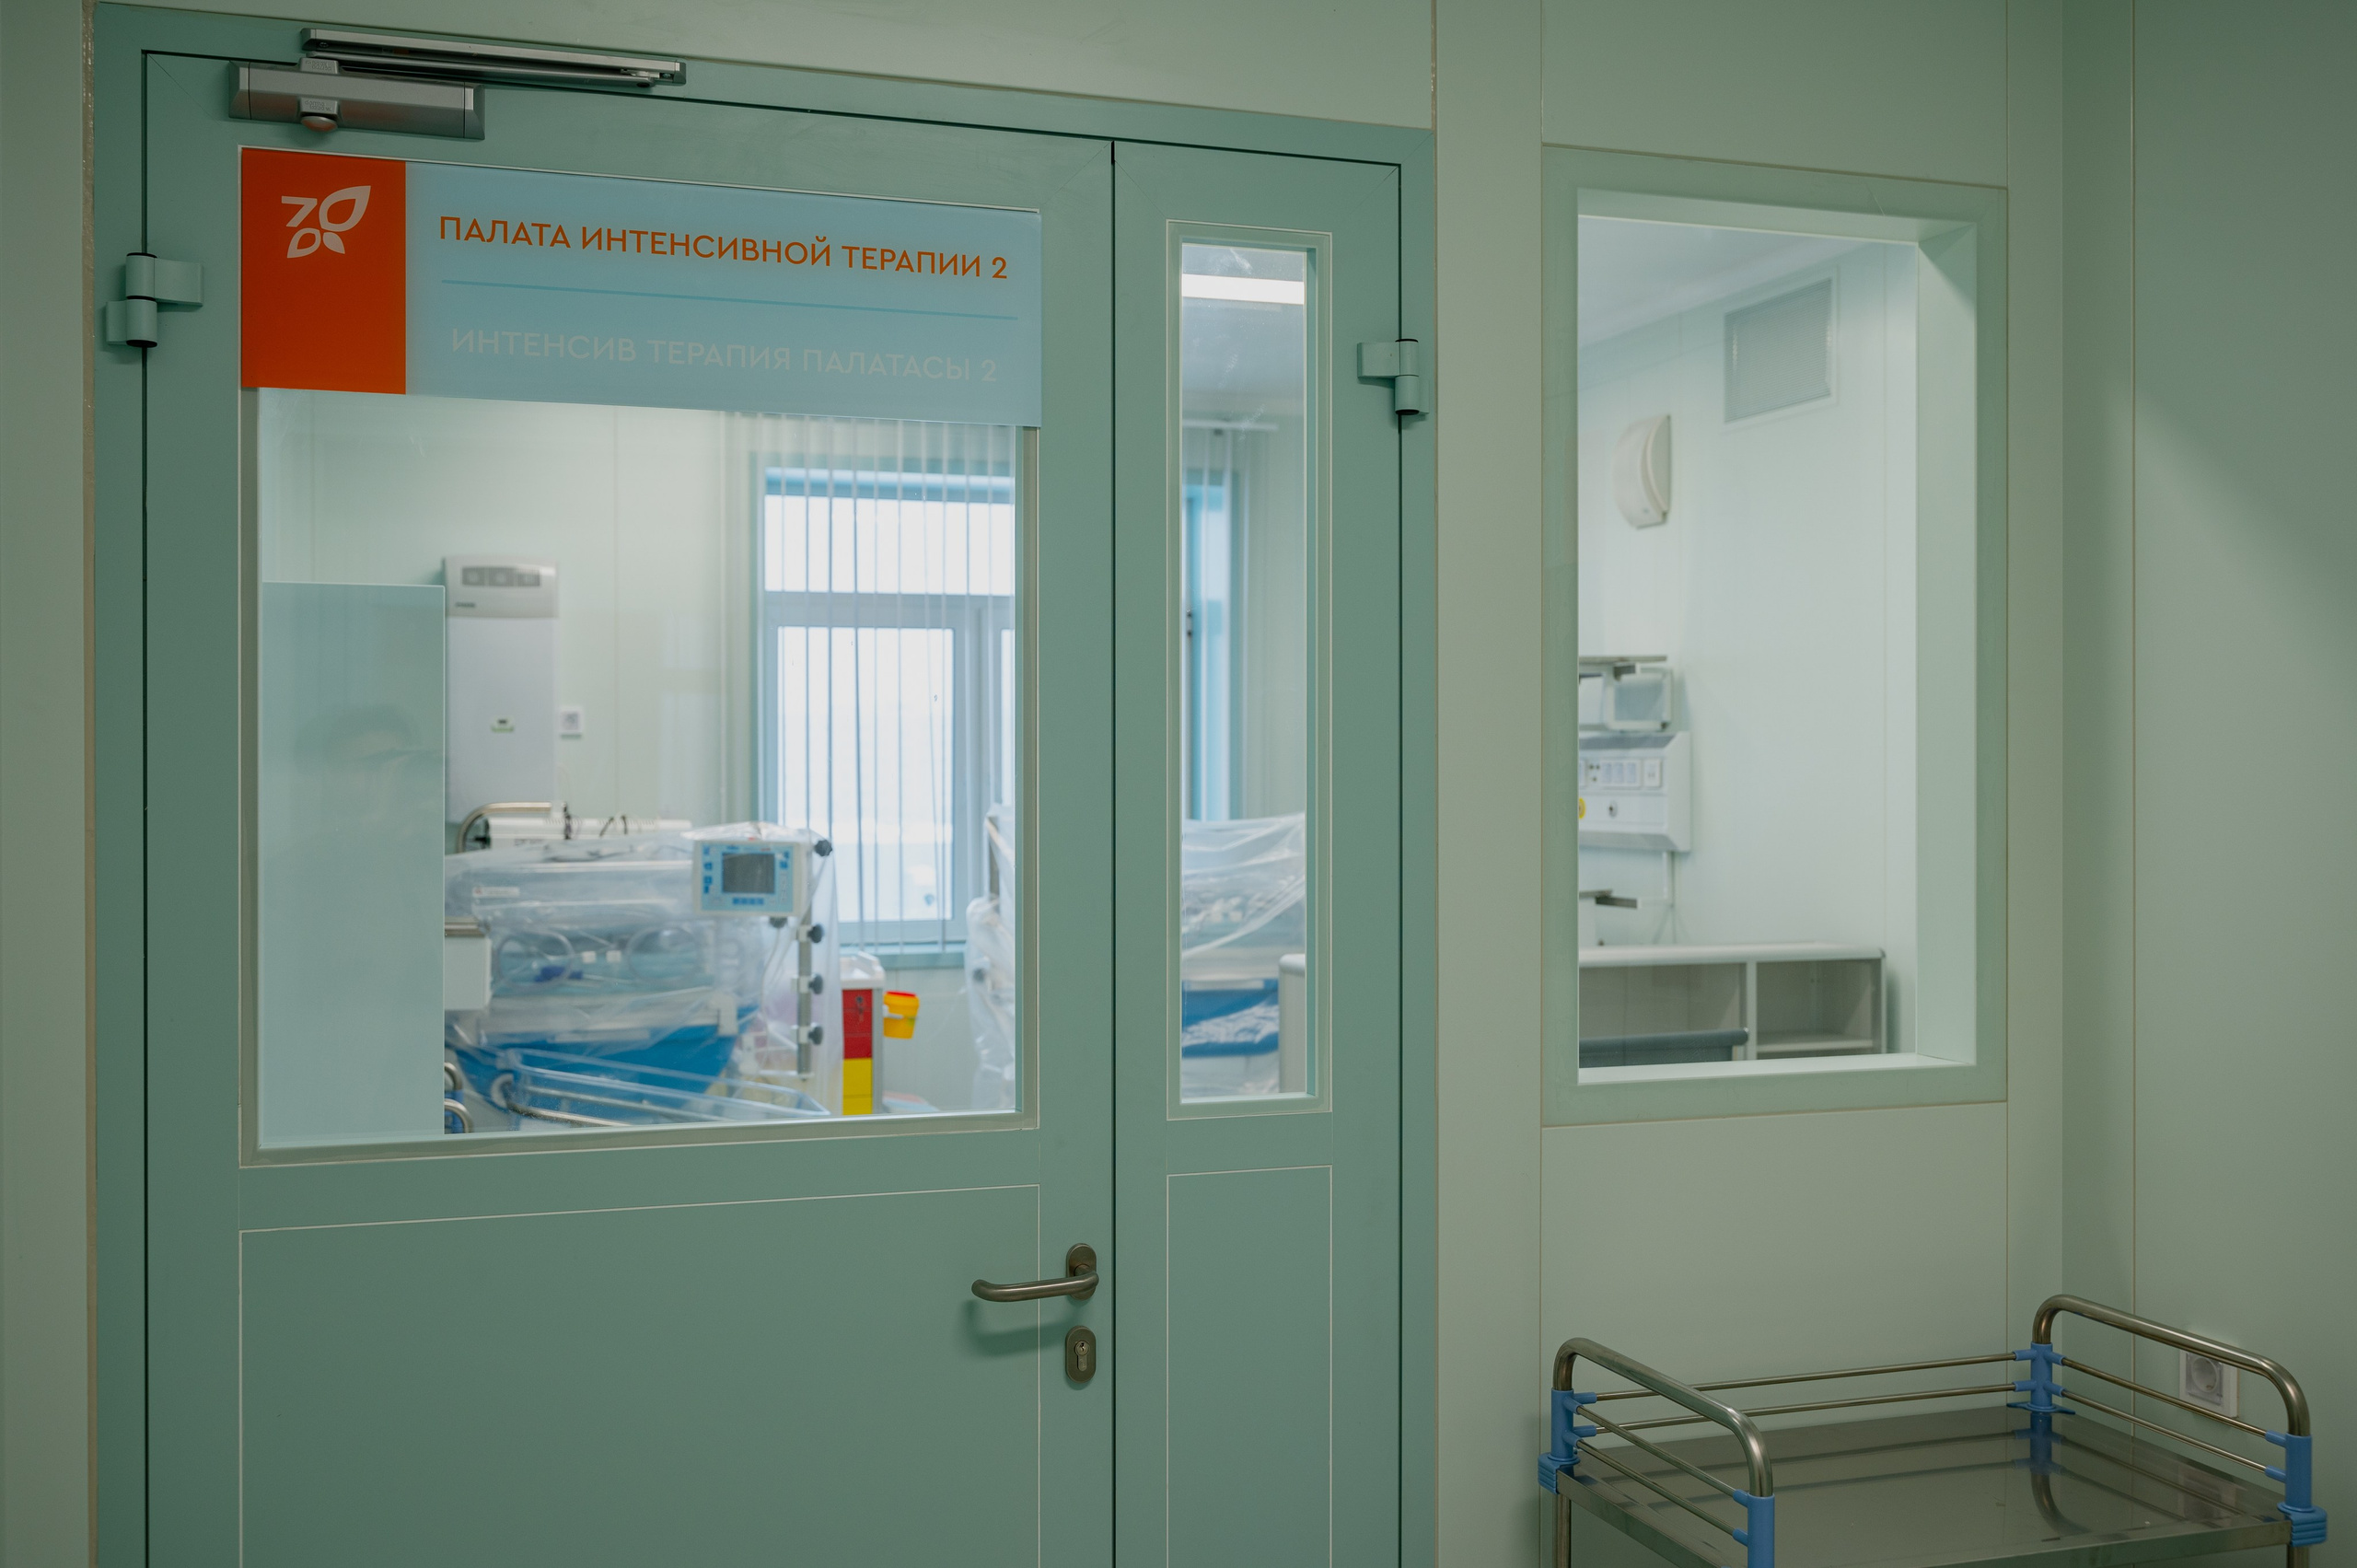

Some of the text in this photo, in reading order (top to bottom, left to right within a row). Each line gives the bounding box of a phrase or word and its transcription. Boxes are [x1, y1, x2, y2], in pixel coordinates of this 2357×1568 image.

[439, 215, 1009, 281] ПАЛАТА ИНТЕНСИВНОЙ ТЕРАПИИ 2
[451, 327, 998, 382] ИНТЕНСИВ ТЕРАПИЯ ПАЛАТАСЫ 2
